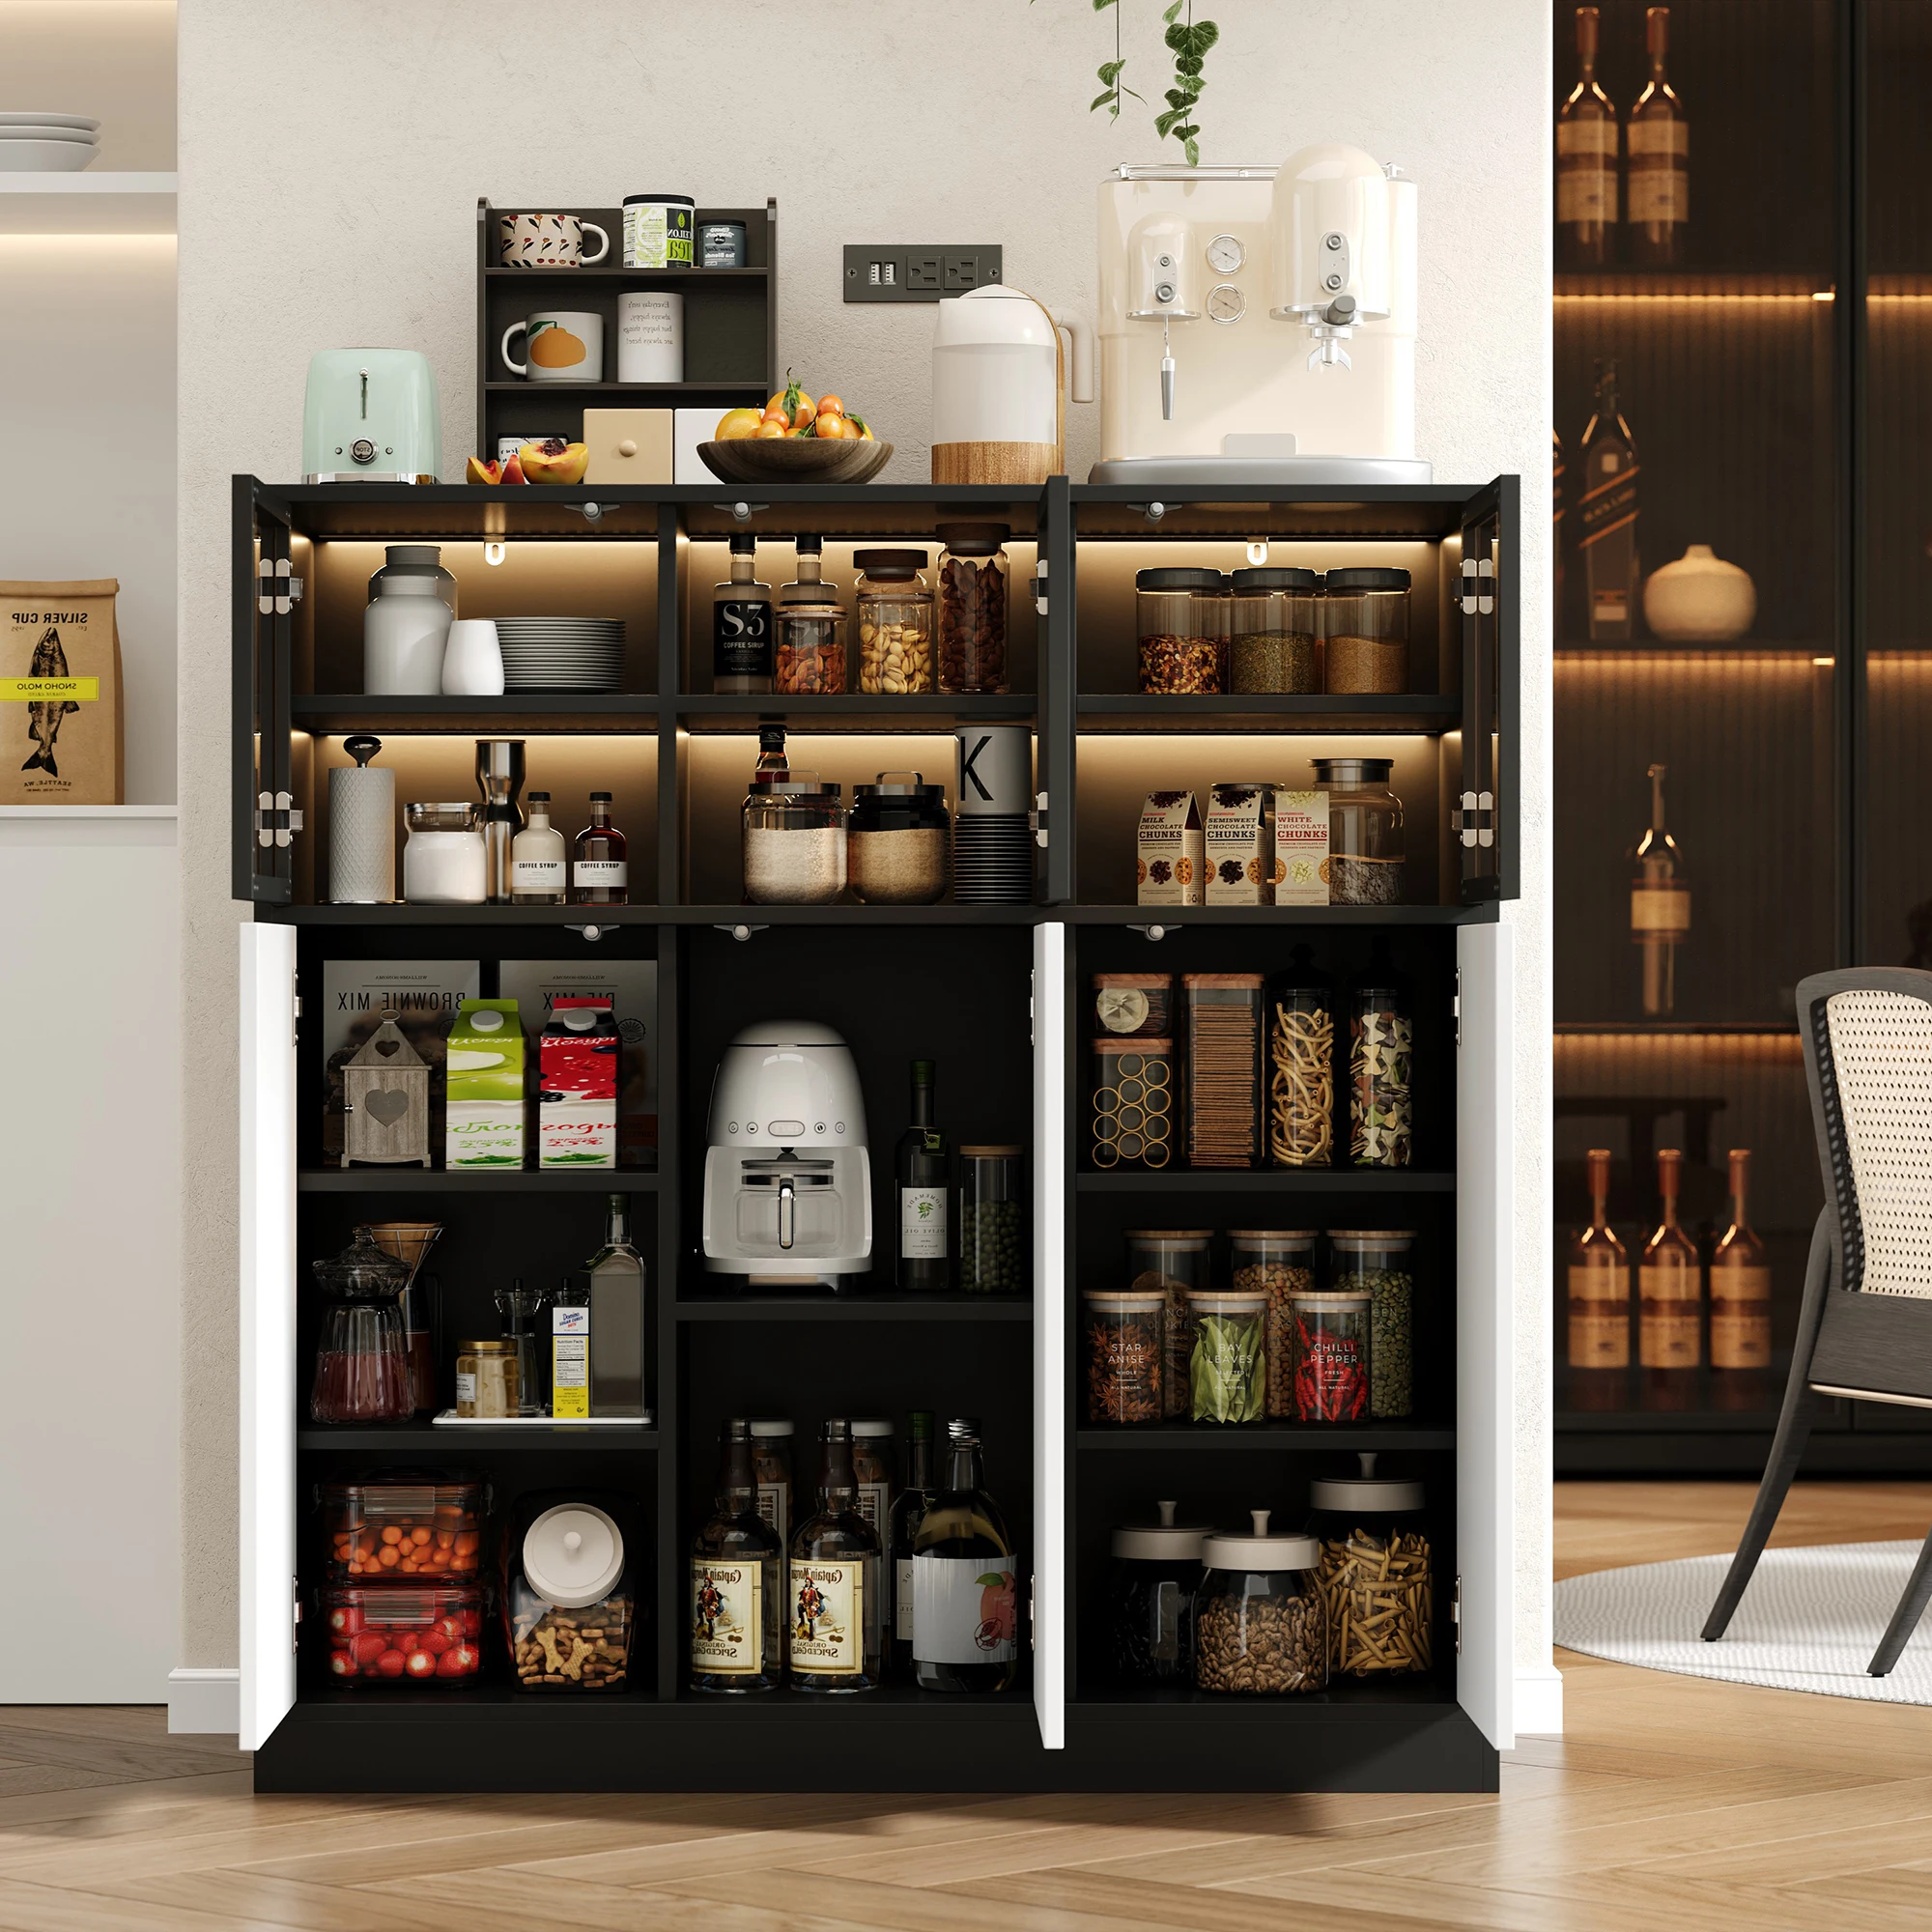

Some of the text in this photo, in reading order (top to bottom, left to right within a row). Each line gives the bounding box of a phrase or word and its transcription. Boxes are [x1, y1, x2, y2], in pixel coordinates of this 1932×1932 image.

[722, 603, 765, 637] S3
[960, 735, 995, 802] K
[1277, 830, 1328, 838] CHUNKS
[1111, 1343, 1142, 1352] STAR
[1218, 1343, 1242, 1352] BAY
[1314, 1343, 1354, 1352] CHILLI
[1108, 1354, 1145, 1364] ANISE
[1208, 1354, 1253, 1364] LEAVES
[1310, 1354, 1357, 1364] PEPPER
